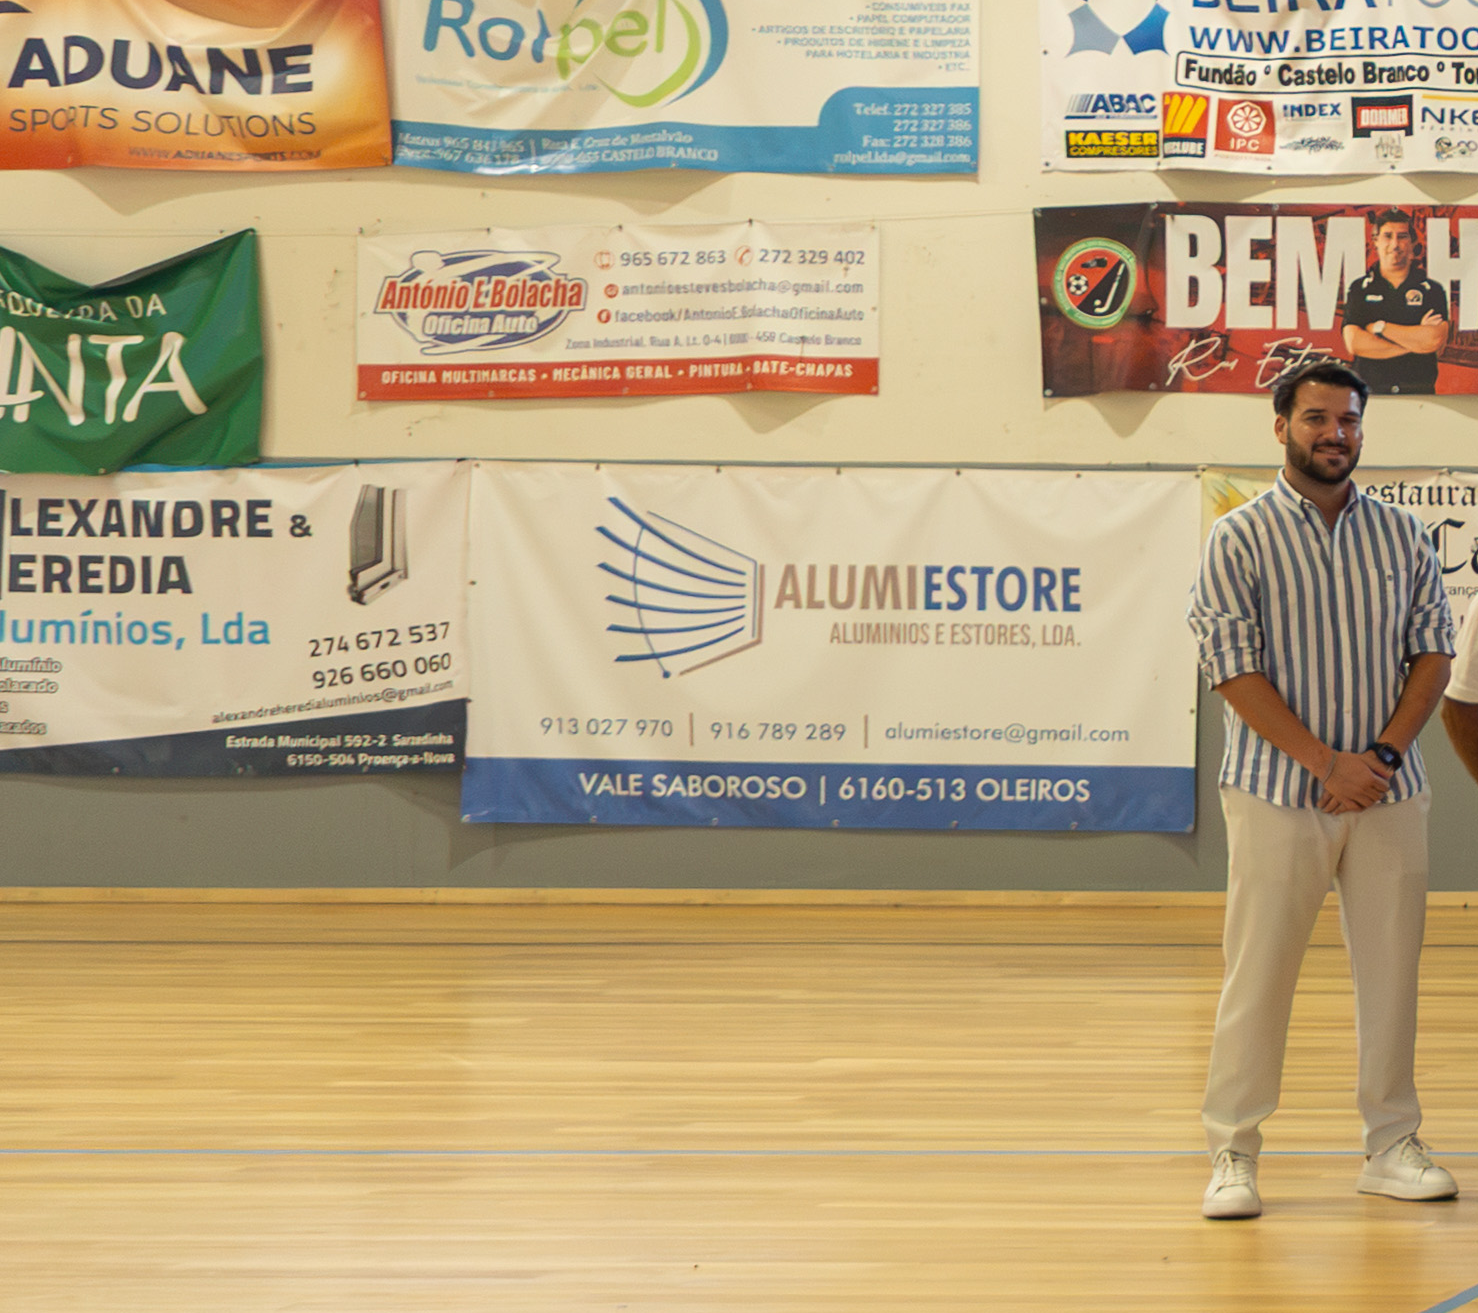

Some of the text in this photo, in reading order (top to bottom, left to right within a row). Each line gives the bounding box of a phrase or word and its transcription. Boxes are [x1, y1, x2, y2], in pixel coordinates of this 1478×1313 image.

[9, 35, 313, 95] ADUANE
[1184, 58, 1256, 86] Fundão
[1278, 62, 1355, 86] Castelo
[1363, 60, 1429, 84] Branco
[1092, 94, 1157, 113] ABAC
[1283, 103, 1341, 117] INDEX
[131, 110, 316, 138] SOLUTIONS
[1068, 131, 1157, 146] KAESER
[1229, 138, 1260, 151] IPC
[621, 249, 865, 266] 965 672 863 272 329 402
[1165, 214, 1366, 330] BEM
[126, 294, 167, 318] DA
[381, 277, 583, 309] António E Bolacha
[10, 497, 312, 538] LEXANDRE &
[8, 554, 192, 595] EREDIA
[774, 563, 1082, 613] ALUMIESTORE
[201, 612, 271, 645] Lda
[309, 621, 451, 658] 274 672 537
[312, 652, 451, 689] 926 660 060
[226, 735, 275, 748] Estrada
[278, 735, 340, 750] Municipal
[540, 712, 1129, 745] 913 027 970 916 789 289 alumiestore@gmail.com
[579, 772, 1090, 803] VALE SABOROSO 6160-513 OLEIROS
